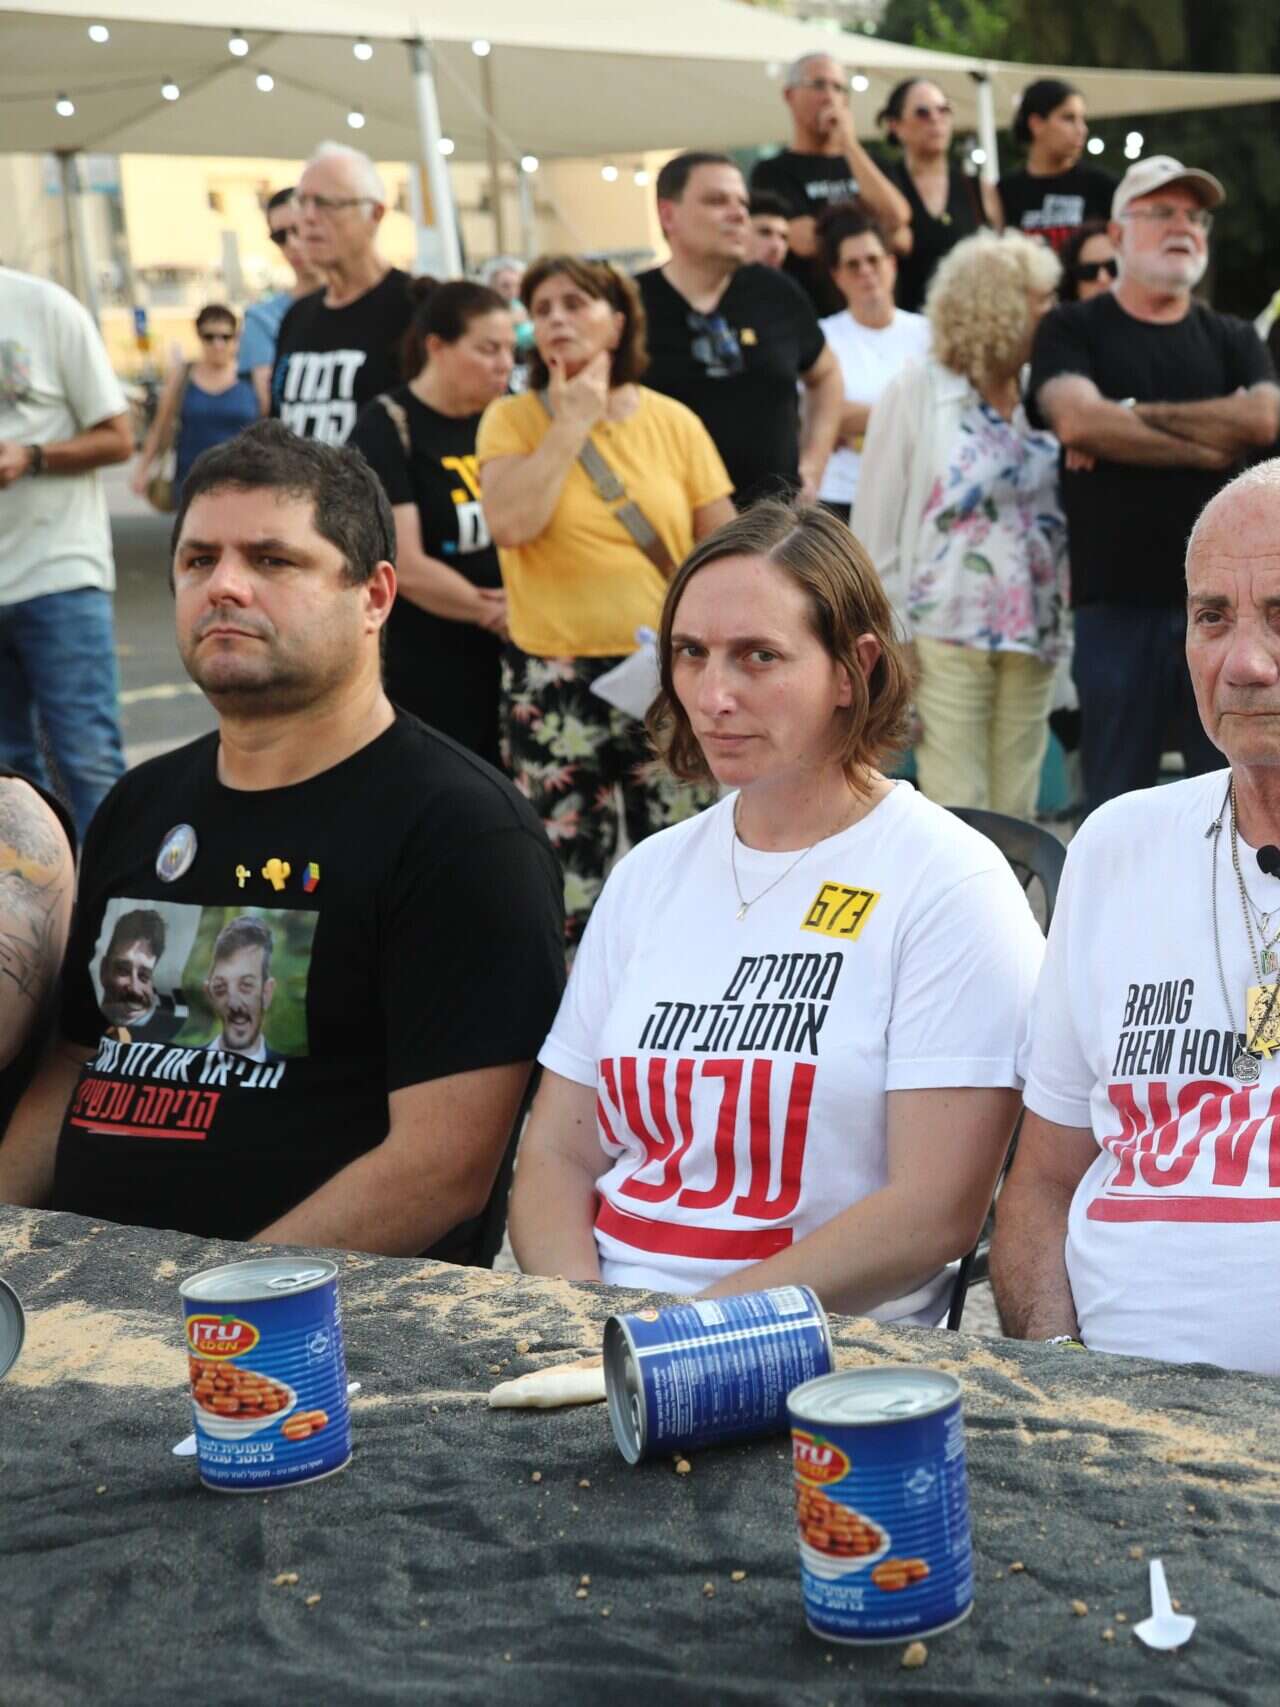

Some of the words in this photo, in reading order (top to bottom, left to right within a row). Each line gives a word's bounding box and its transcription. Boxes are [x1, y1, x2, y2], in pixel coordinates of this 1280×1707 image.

[804, 884, 876, 933] 673
[722, 951, 844, 1001] מחזירים
[638, 1001, 740, 1053] הביתה
[1122, 978, 1194, 1029] BRING
[736, 1003, 829, 1056] אותם
[1111, 1028, 1175, 1077] THEM
[1177, 1028, 1262, 1080] HOM
[151, 1047, 202, 1083] את
[199, 1049, 286, 1089] הביאו
[131, 1084, 222, 1130] הביתה
[193, 1322, 242, 1346] עדן
